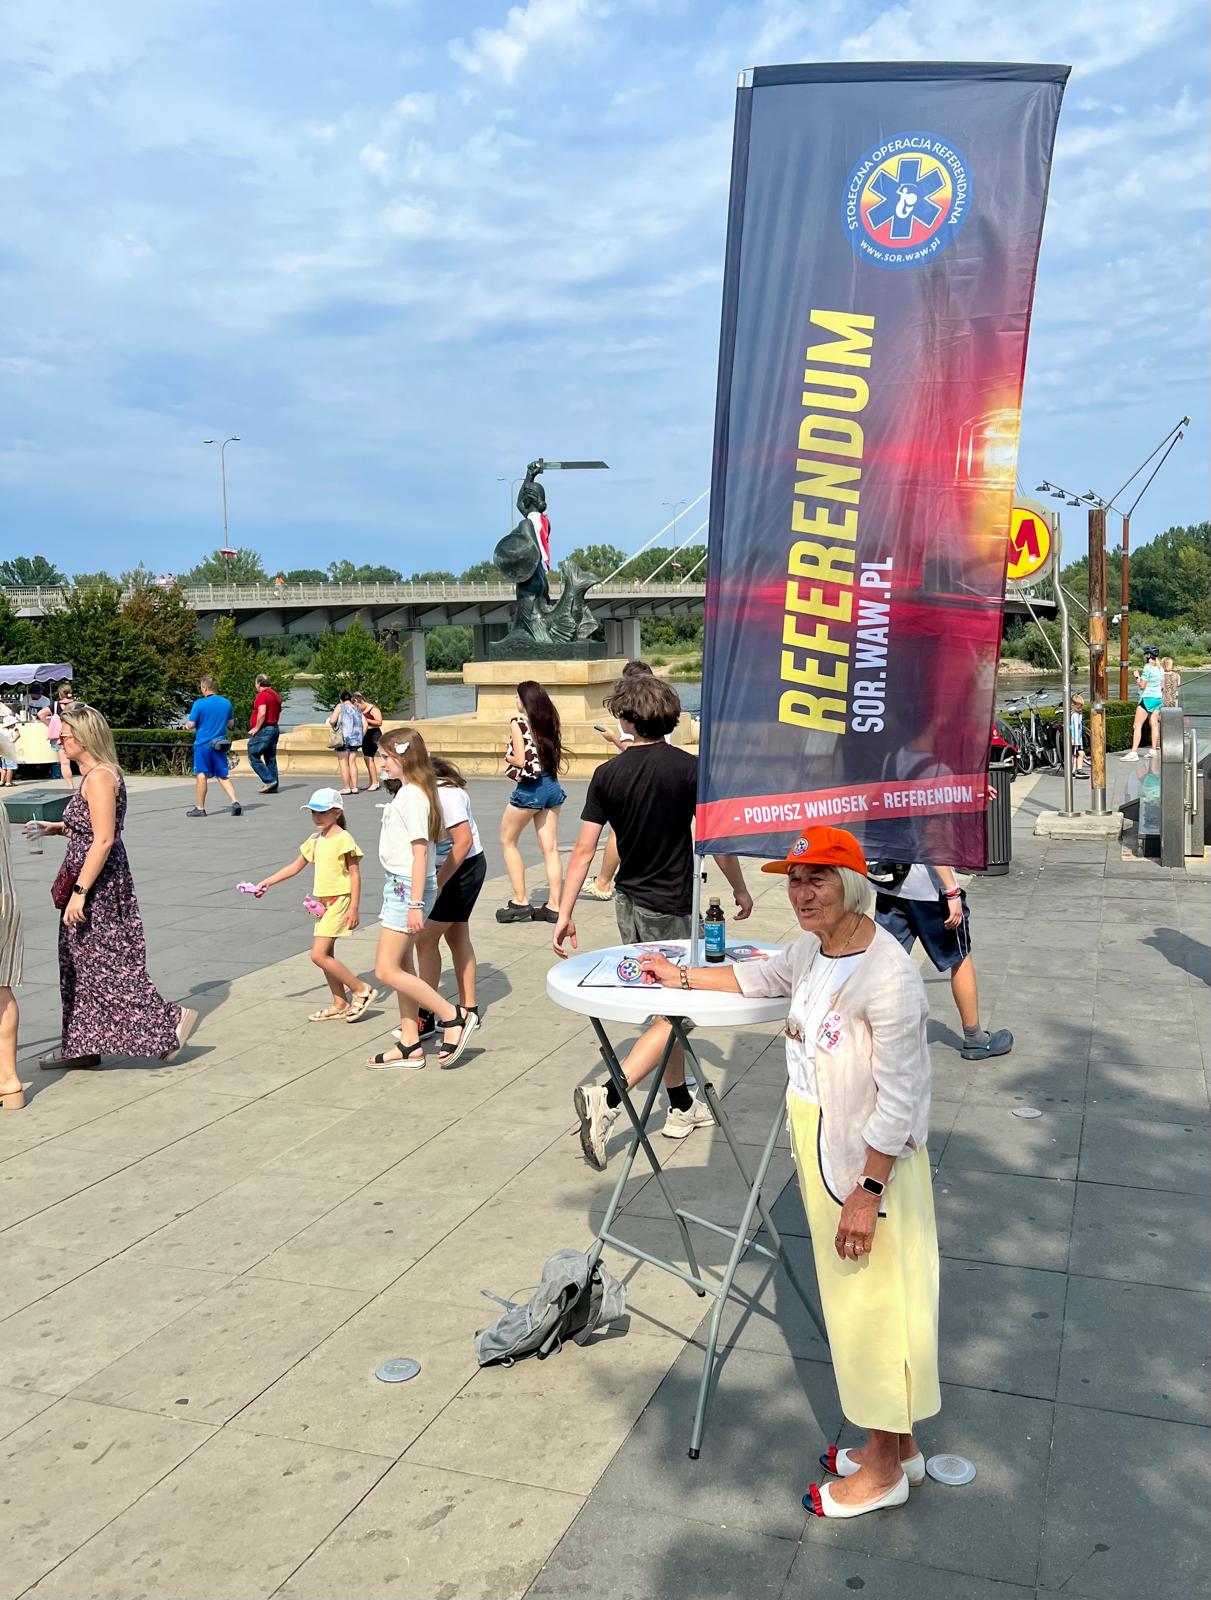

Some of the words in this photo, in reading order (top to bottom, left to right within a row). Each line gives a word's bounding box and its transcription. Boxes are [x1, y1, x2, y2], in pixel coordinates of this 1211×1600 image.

[846, 160, 873, 230] STOŁECZNA
[872, 137, 931, 162] OPERACJA
[932, 142, 967, 224] REFERENDALNA
[778, 308, 876, 735] REFERENDUM
[852, 556, 893, 734] SOR.WAW.PL
[743, 803, 801, 824] PODPISZ
[804, 794, 869, 819] WNIOSEK
[883, 785, 973, 809] REFERENDUM
